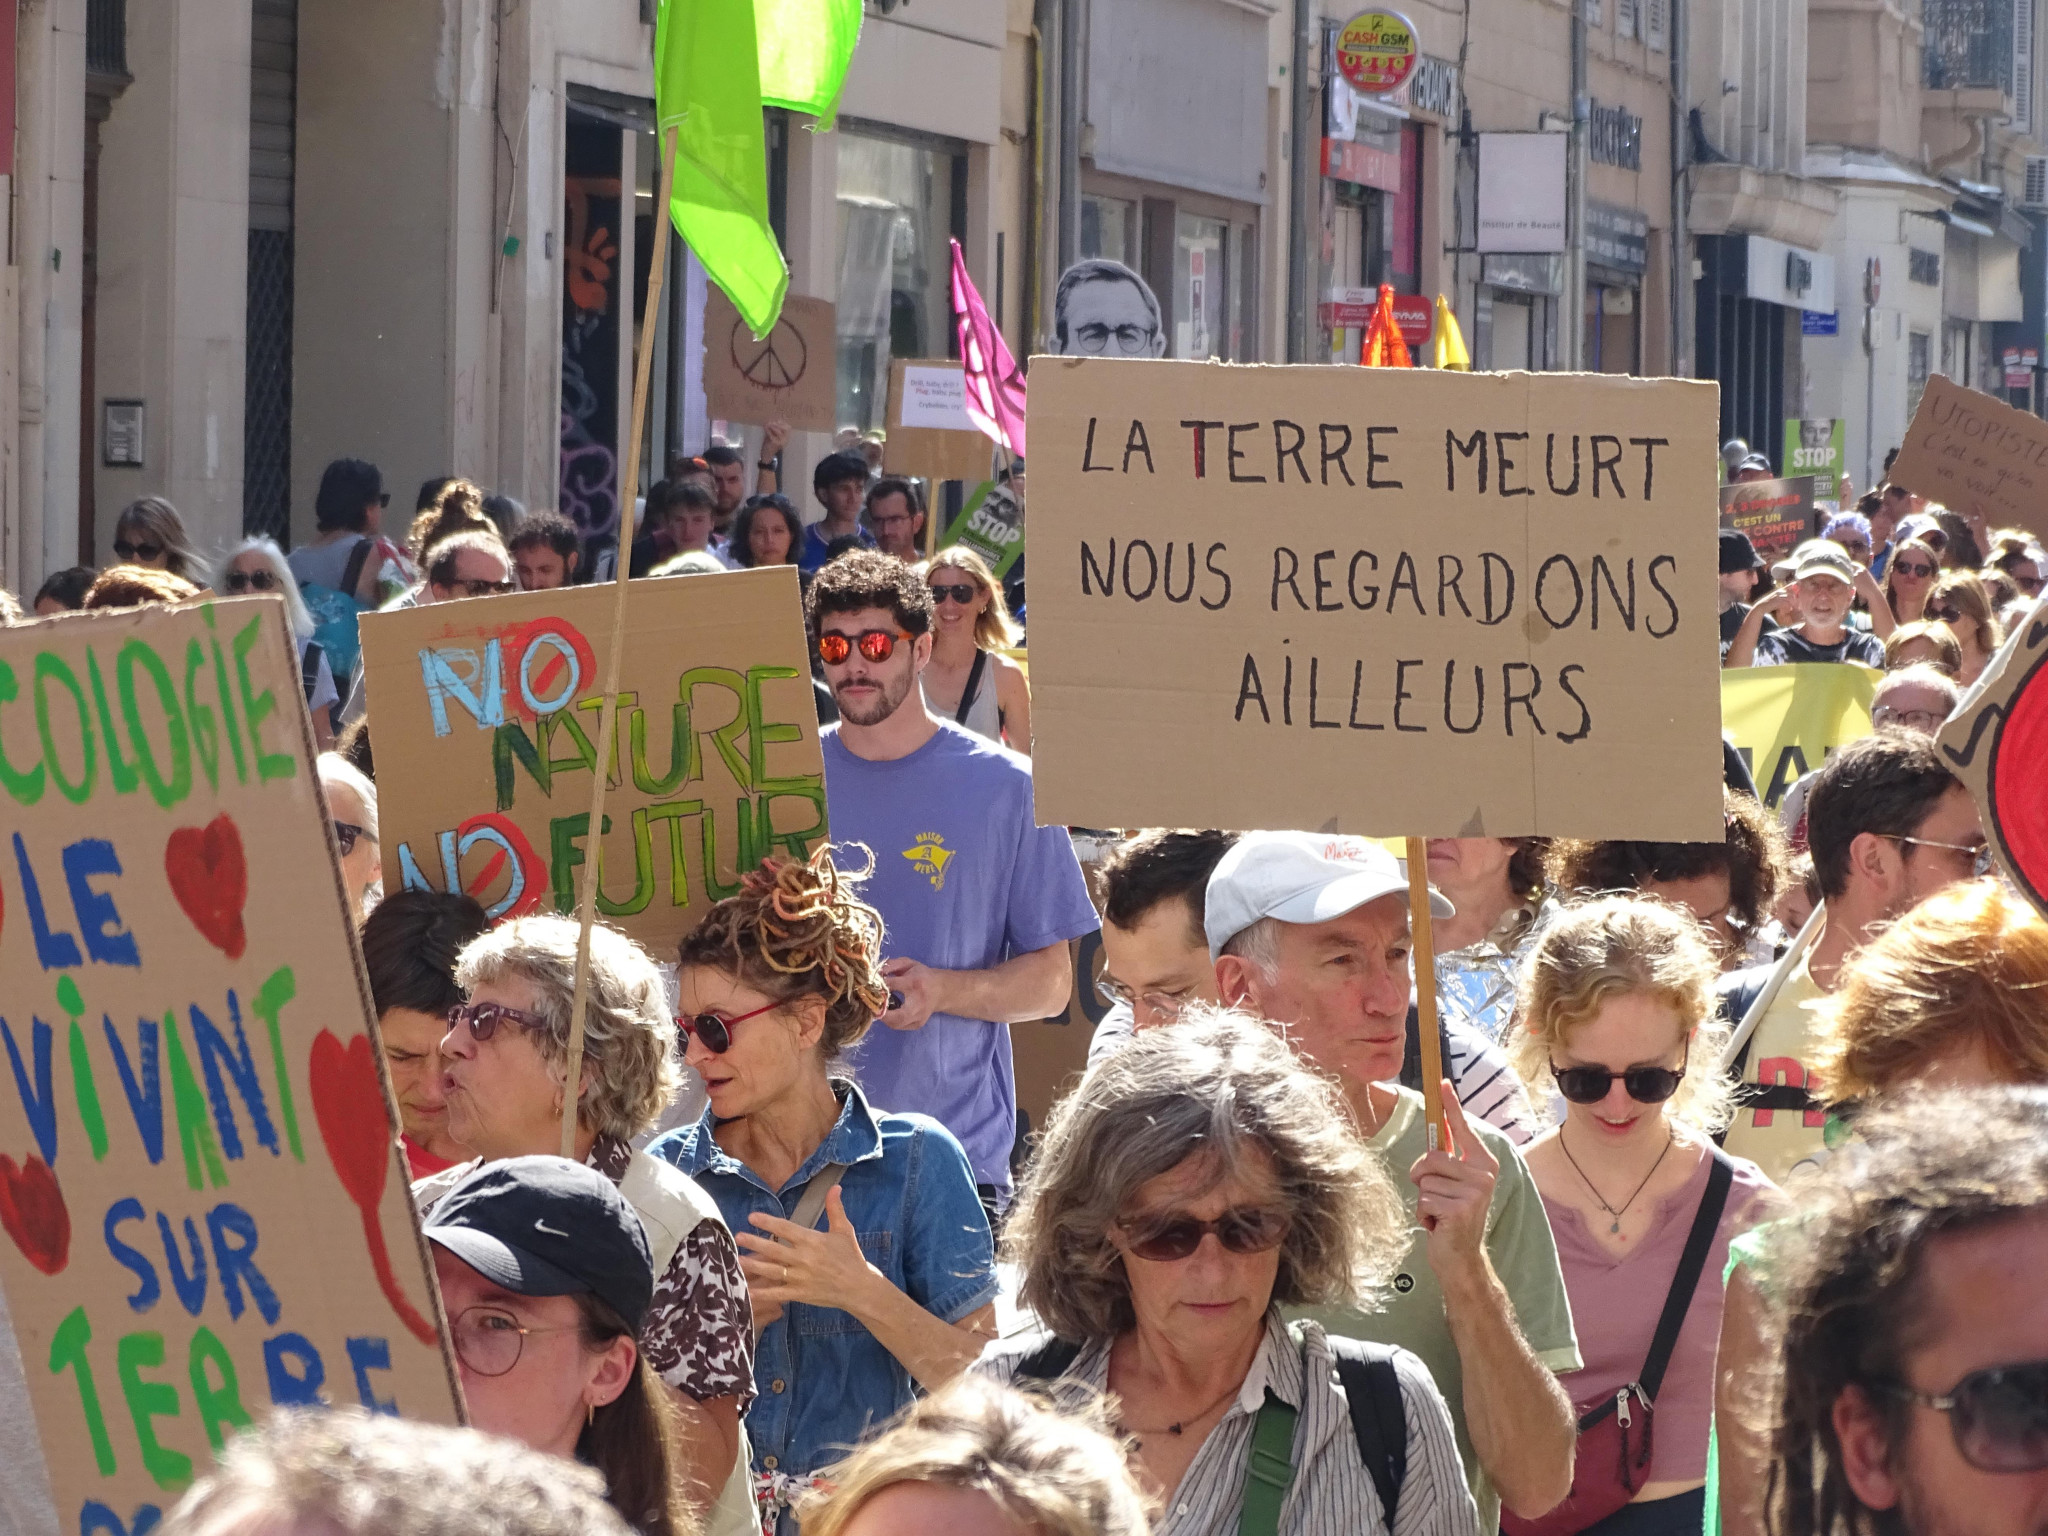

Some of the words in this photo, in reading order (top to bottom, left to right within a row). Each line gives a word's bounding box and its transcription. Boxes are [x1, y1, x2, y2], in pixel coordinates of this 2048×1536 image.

[1344, 31, 1378, 44] CASH
[1381, 33, 1409, 46] GSM
[1081, 417, 1155, 474] LA
[1180, 420, 1403, 489] TERRE
[1445, 428, 1669, 500] MEURT
[1793, 447, 1837, 468] STOP
[967, 509, 1020, 546] STOP
[1733, 516, 1762, 528] C'EST
[1765, 514, 1782, 523] UN
[1753, 520, 1805, 537] CONTRE
[1081, 537, 1232, 610] NOUS
[1271, 547, 1679, 638] REGARDONS
[418, 632, 582, 737] NO
[491, 665, 823, 813] NATURE
[13, 832, 141, 971] LE
[398, 824, 526, 921] NO
[0, 965, 305, 1190] VIVANT
[104, 1197, 281, 1326] SUR
